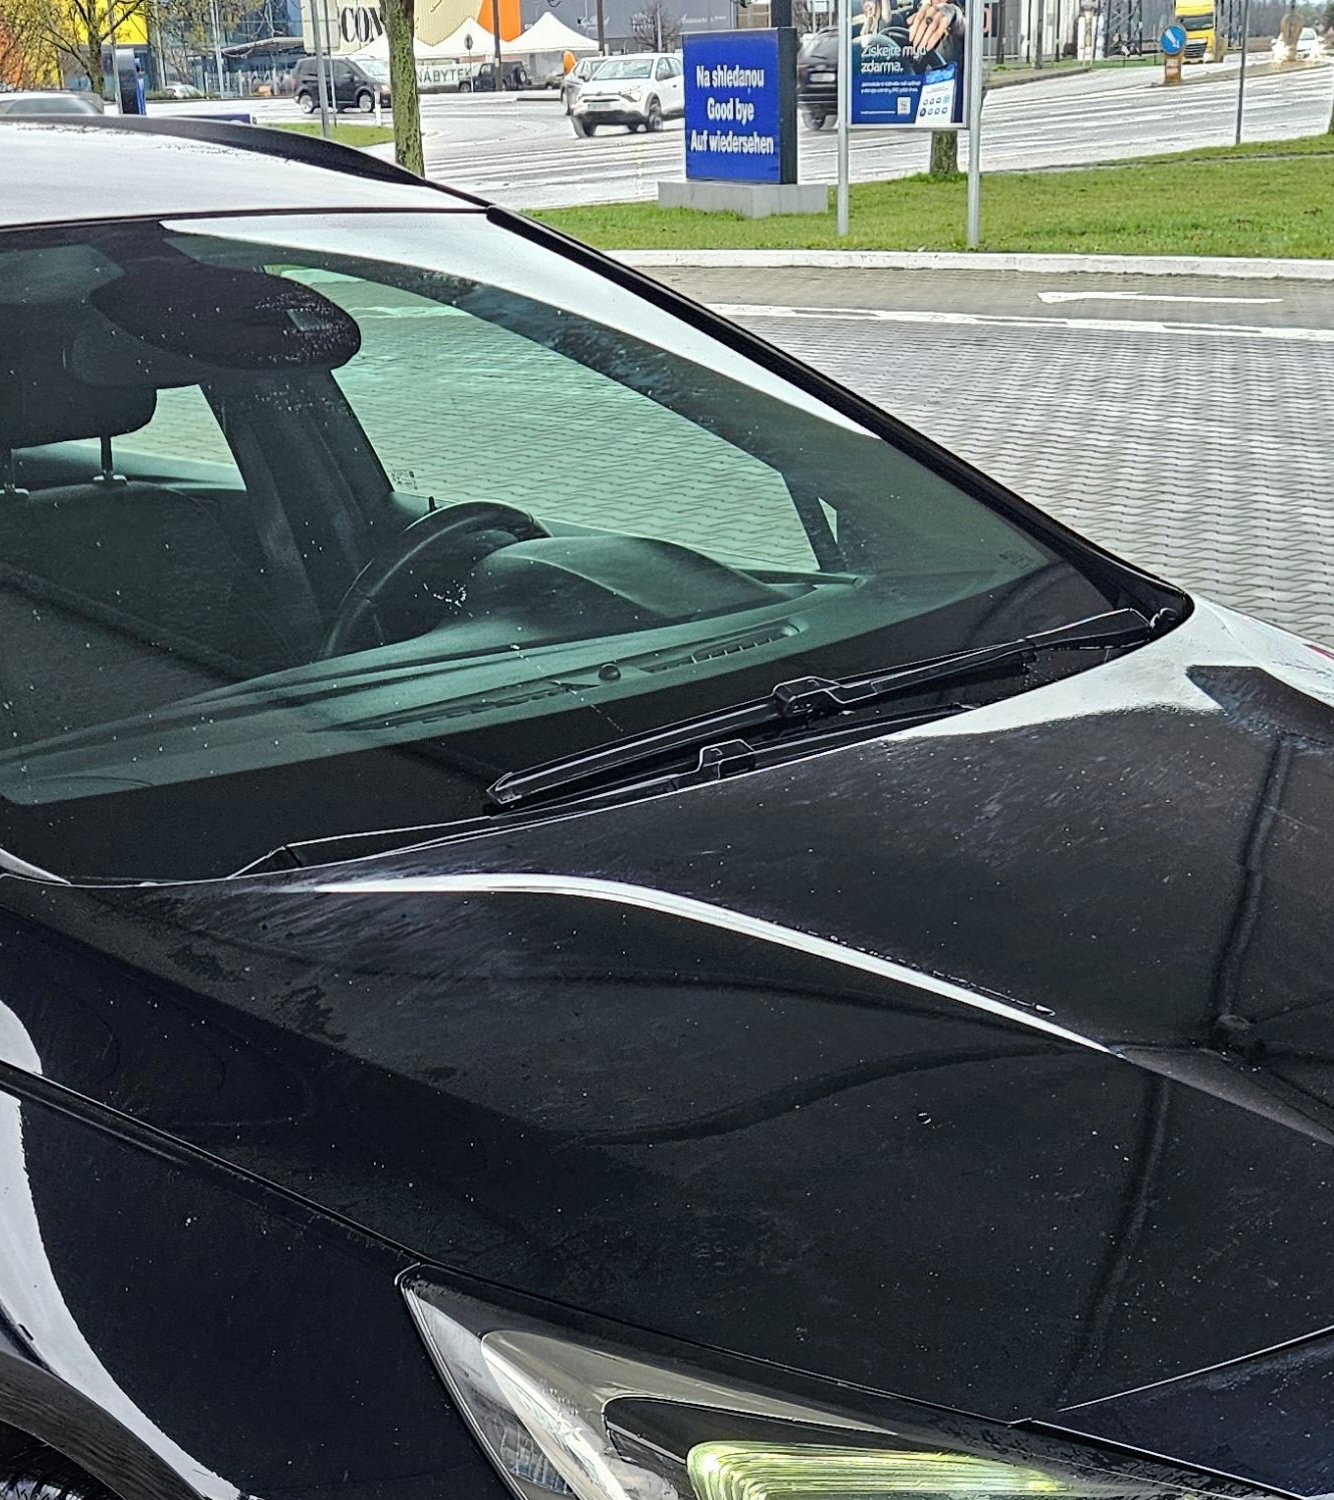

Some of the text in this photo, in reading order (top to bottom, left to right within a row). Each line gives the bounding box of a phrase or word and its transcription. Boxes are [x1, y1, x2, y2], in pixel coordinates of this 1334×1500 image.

[696, 65, 764, 88] Na shledanou
[707, 97, 754, 126] Good bye
[690, 129, 774, 154] Auf wiedersehen
